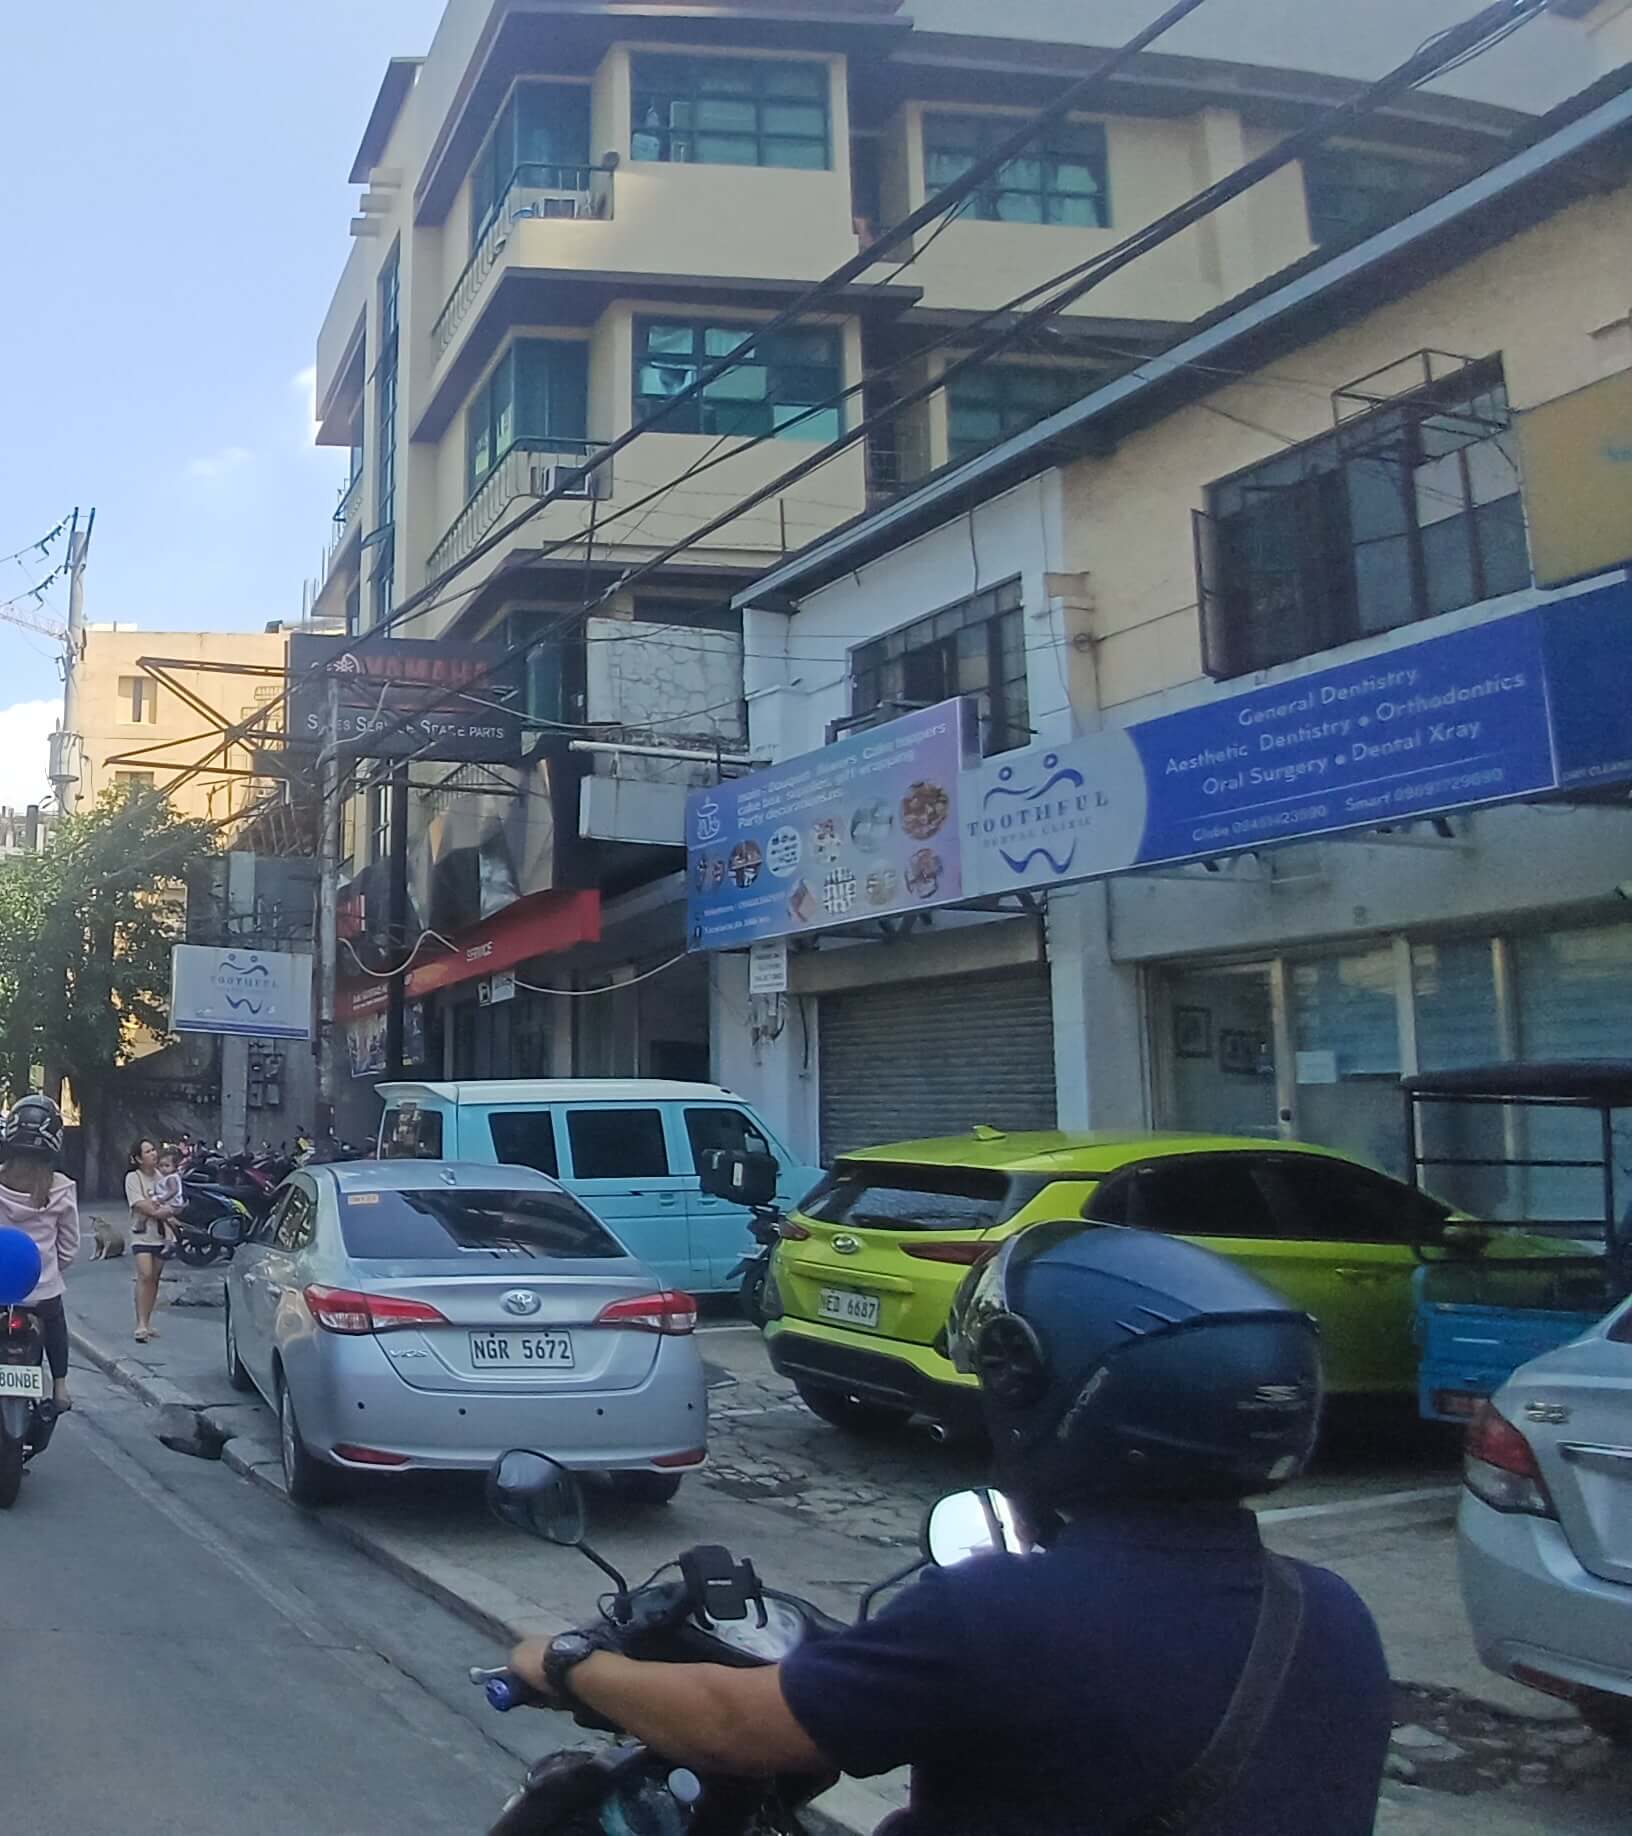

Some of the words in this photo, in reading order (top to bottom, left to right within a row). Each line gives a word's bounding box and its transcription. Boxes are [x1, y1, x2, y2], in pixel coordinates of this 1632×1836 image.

[1238, 692, 1315, 726] General
[1321, 669, 1418, 704] Dentistry
[469, 726, 505, 739] PARTS
[1166, 743, 1249, 775] Aesthetic
[1259, 718, 1352, 751] Dentistry
[1376, 672, 1526, 721] Orthodontics
[1202, 772, 1244, 794] Oral
[1249, 756, 1329, 784] Surgery
[1352, 731, 1422, 761] Dental
[1428, 721, 1481, 744] Xray
[966, 791, 1109, 837] TOOTHFUL
[473, 1339, 510, 1361] NGR
[522, 1339, 571, 1360] 5672
